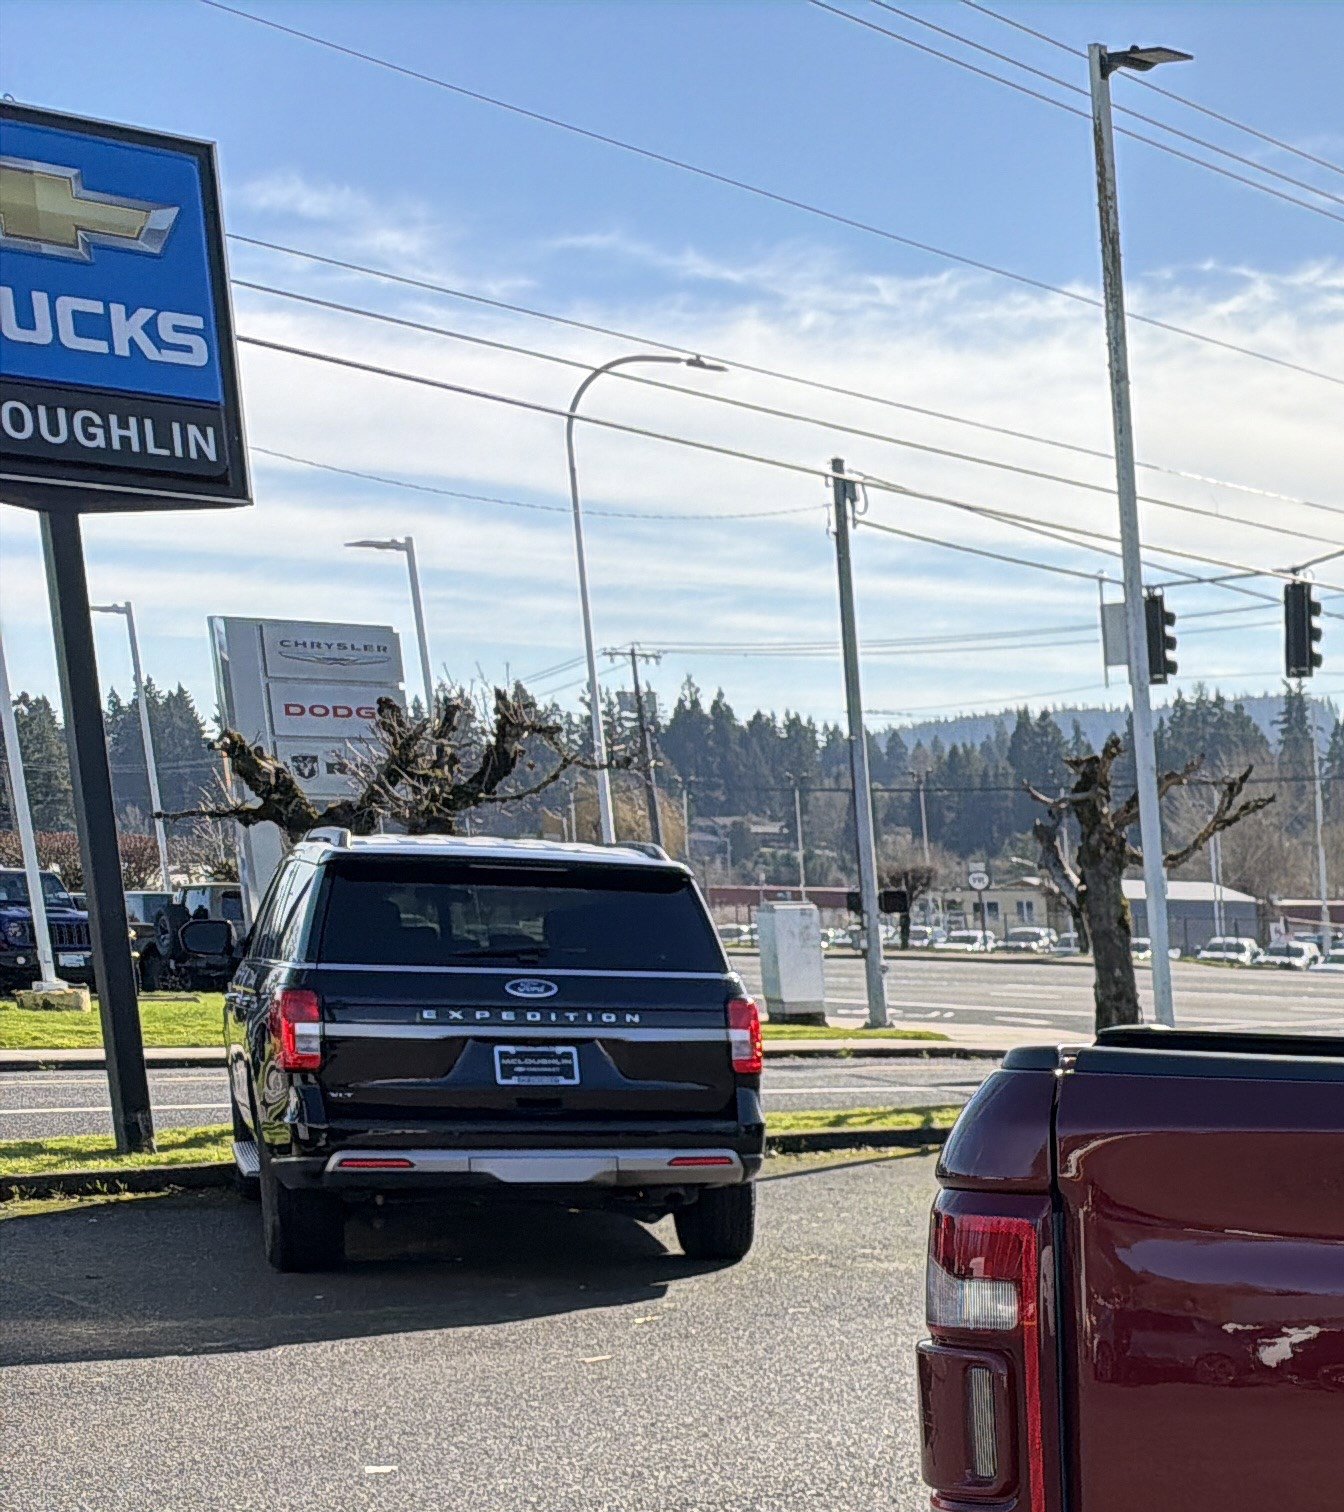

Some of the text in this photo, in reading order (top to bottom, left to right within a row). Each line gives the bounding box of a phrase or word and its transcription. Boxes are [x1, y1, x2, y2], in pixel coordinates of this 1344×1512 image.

[279, 639, 388, 653] CHRYSLER
[284, 703, 376, 719] DODG
[422, 1009, 640, 1024] EXPEDITION
